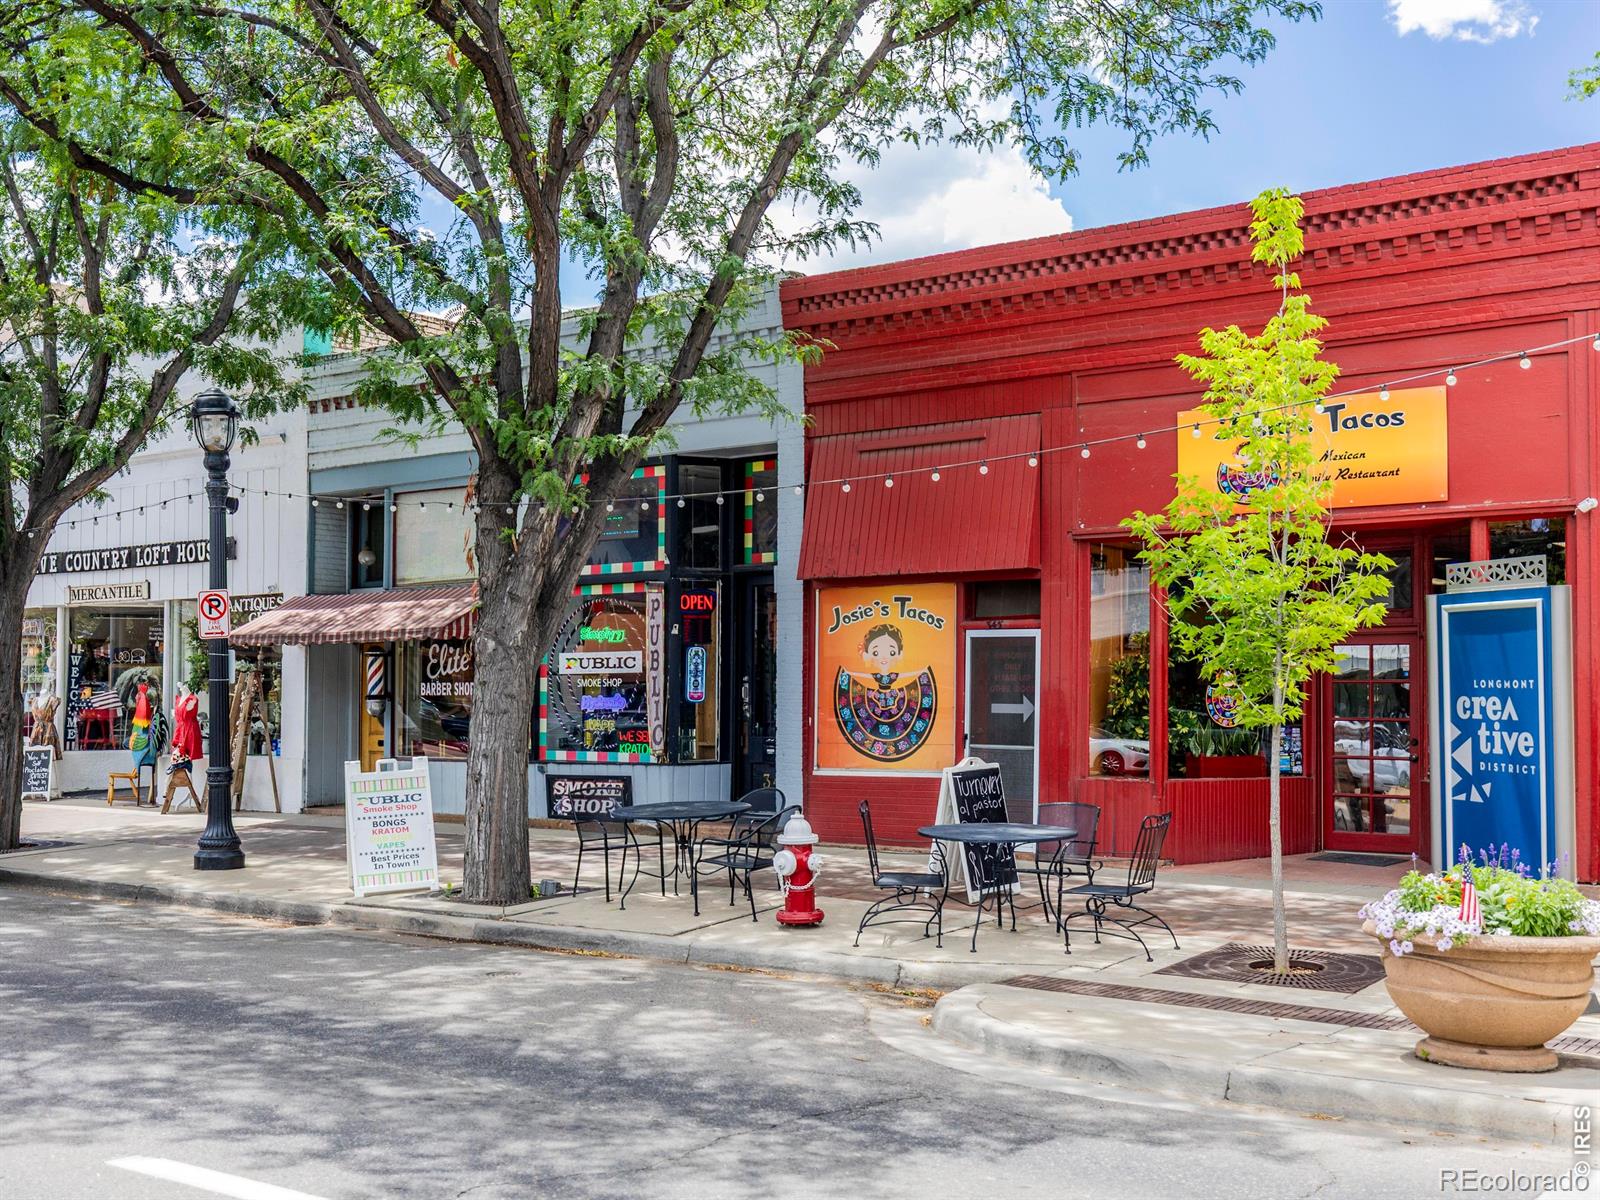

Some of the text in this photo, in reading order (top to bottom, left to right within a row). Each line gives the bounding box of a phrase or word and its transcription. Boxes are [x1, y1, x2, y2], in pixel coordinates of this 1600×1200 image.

[1323, 403, 1405, 433] Tacos
[1319, 449, 1366, 463] Mexican
[1334, 467, 1400, 482] Restaurant
[65, 549, 128, 573] COUNTRY
[135, 544, 171, 567] LOFT
[71, 584, 143, 601] MERCANTILE
[229, 596, 284, 612] ANTIQUES
[680, 594, 713, 610] OPEN
[828, 594, 945, 634] Josie's Tacos
[427, 643, 470, 679] Elite
[565, 656, 637, 670] PUBLIC
[650, 598, 664, 747] PUBLIC
[420, 682, 452, 696] BARBER
[577, 678, 623, 688] SMOKE SHOP
[1473, 679, 1535, 689] LONGMONT
[617, 730, 635, 742] WE
[1477, 721, 1534, 757] tive
[619, 743, 650, 754] KRATO
[1480, 761, 1536, 775] DISTRICT
[553, 780, 624, 796] SMOKE
[562, 797, 613, 814] SHOP
[960, 796, 1002, 819] al pastor
[372, 818, 407, 828] BONGS
[372, 826, 409, 836] KRATOM
[377, 841, 406, 849] VAPES
[371, 852, 420, 863] Best Prices
[387, 860, 411, 869] Town
